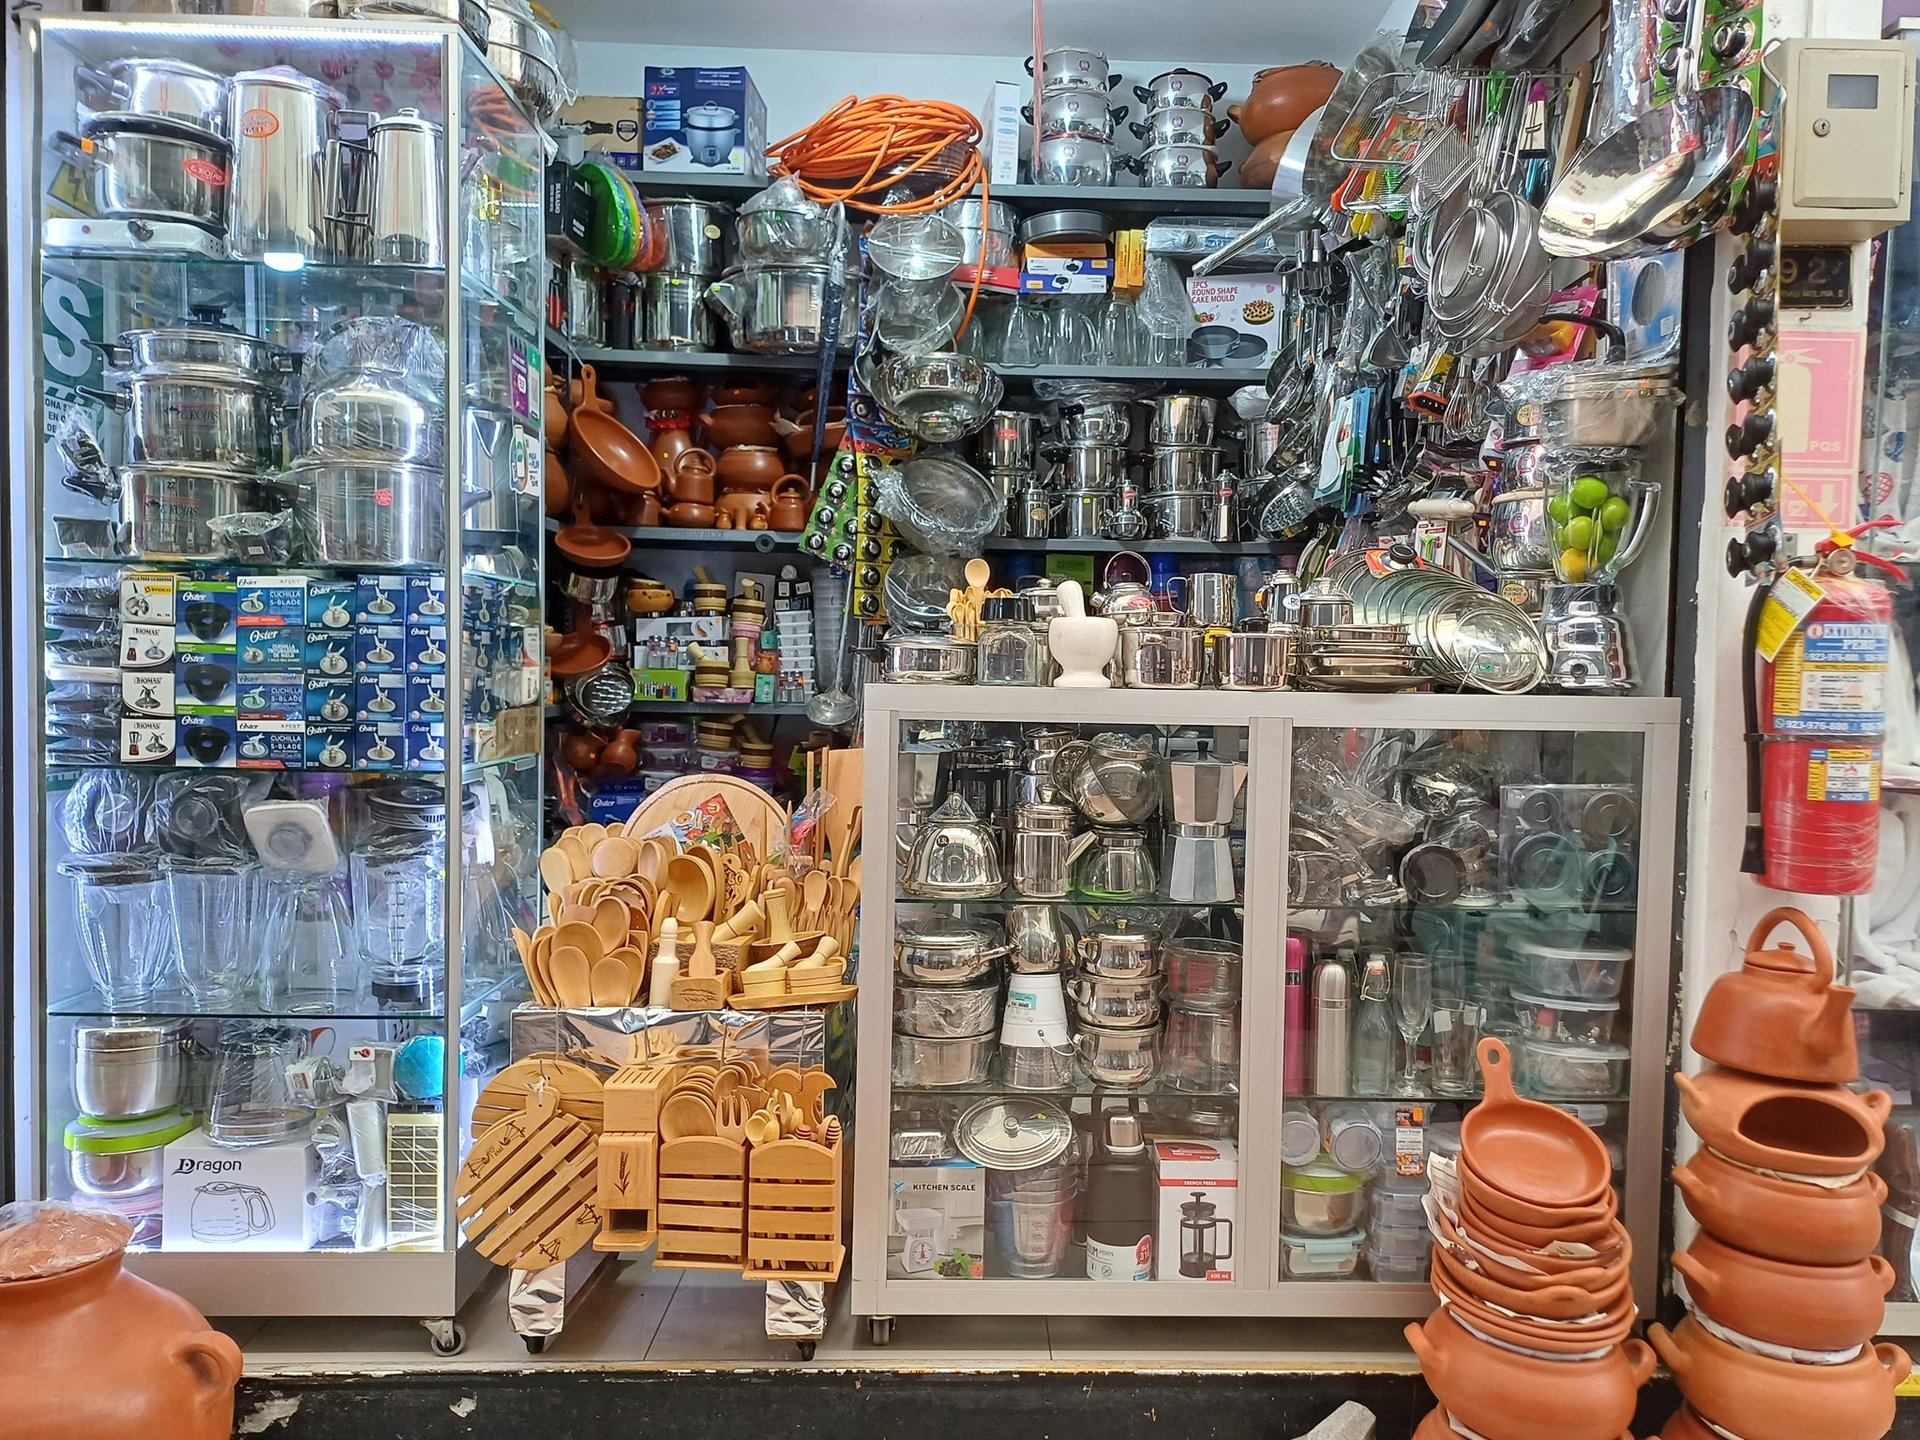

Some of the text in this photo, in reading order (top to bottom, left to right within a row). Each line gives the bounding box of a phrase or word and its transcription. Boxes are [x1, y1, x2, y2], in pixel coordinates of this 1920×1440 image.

[1191, 281, 1208, 289] 3PCS
[1191, 286, 1238, 296] ROUND SHAPE
[1191, 293, 1236, 304] CAKE MOULD
[1809, 440, 1841, 452] PQS
[238, 578, 258, 587] Oster
[360, 577, 378, 587] Oster
[411, 578, 430, 587] Oster
[182, 591, 207, 602] Oster
[269, 590, 301, 598] CUCHILLA
[309, 586, 331, 597] Oster
[359, 626, 377, 636] Oster
[410, 627, 430, 636] Oster
[249, 629, 279, 644] Oster
[307, 632, 329, 643] Oster
[181, 653, 206, 664] Oster
[308, 680, 330, 690] Oster
[360, 675, 378, 685] Oster
[412, 676, 430, 685] Oster
[270, 687, 302, 695] CUCHILLA
[181, 715, 206, 727] Oster
[239, 722, 259, 731] Oster
[306, 726, 328, 737] Oster
[358, 724, 378, 733] Oster
[411, 724, 430, 733] Oster
[270, 735, 302, 743] CUCHILLA
[592, 798, 617, 809] Oster
[172, 1158, 242, 1175] Dragon
[912, 1183, 977, 1192] KITCHEN SCALE
